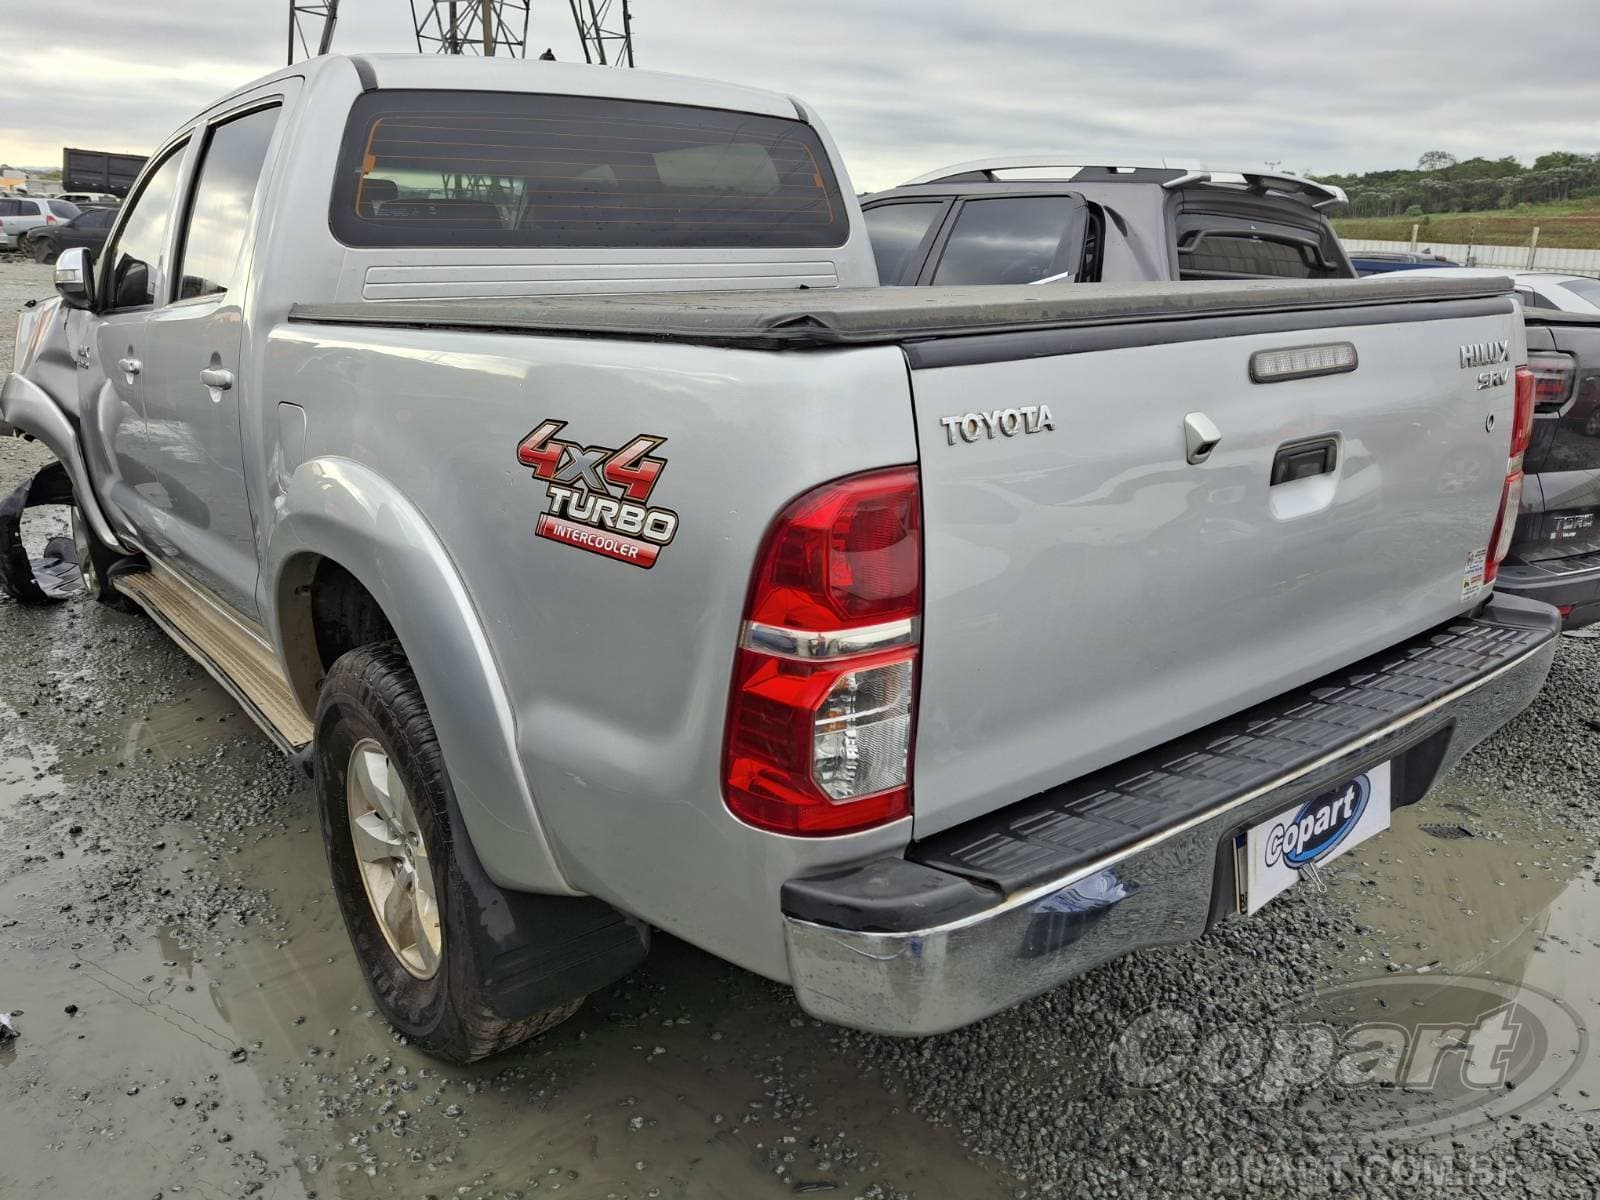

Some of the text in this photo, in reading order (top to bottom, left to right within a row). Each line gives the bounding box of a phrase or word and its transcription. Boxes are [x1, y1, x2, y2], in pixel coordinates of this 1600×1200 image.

[1460, 340, 1509, 368] HILUX
[1476, 368, 1509, 390] SRV
[941, 404, 1055, 446] TOYOTA
[548, 485, 679, 545] TURBO
[553, 524, 639, 559] INTERCOOLER
[1265, 784, 1355, 867] Copart
